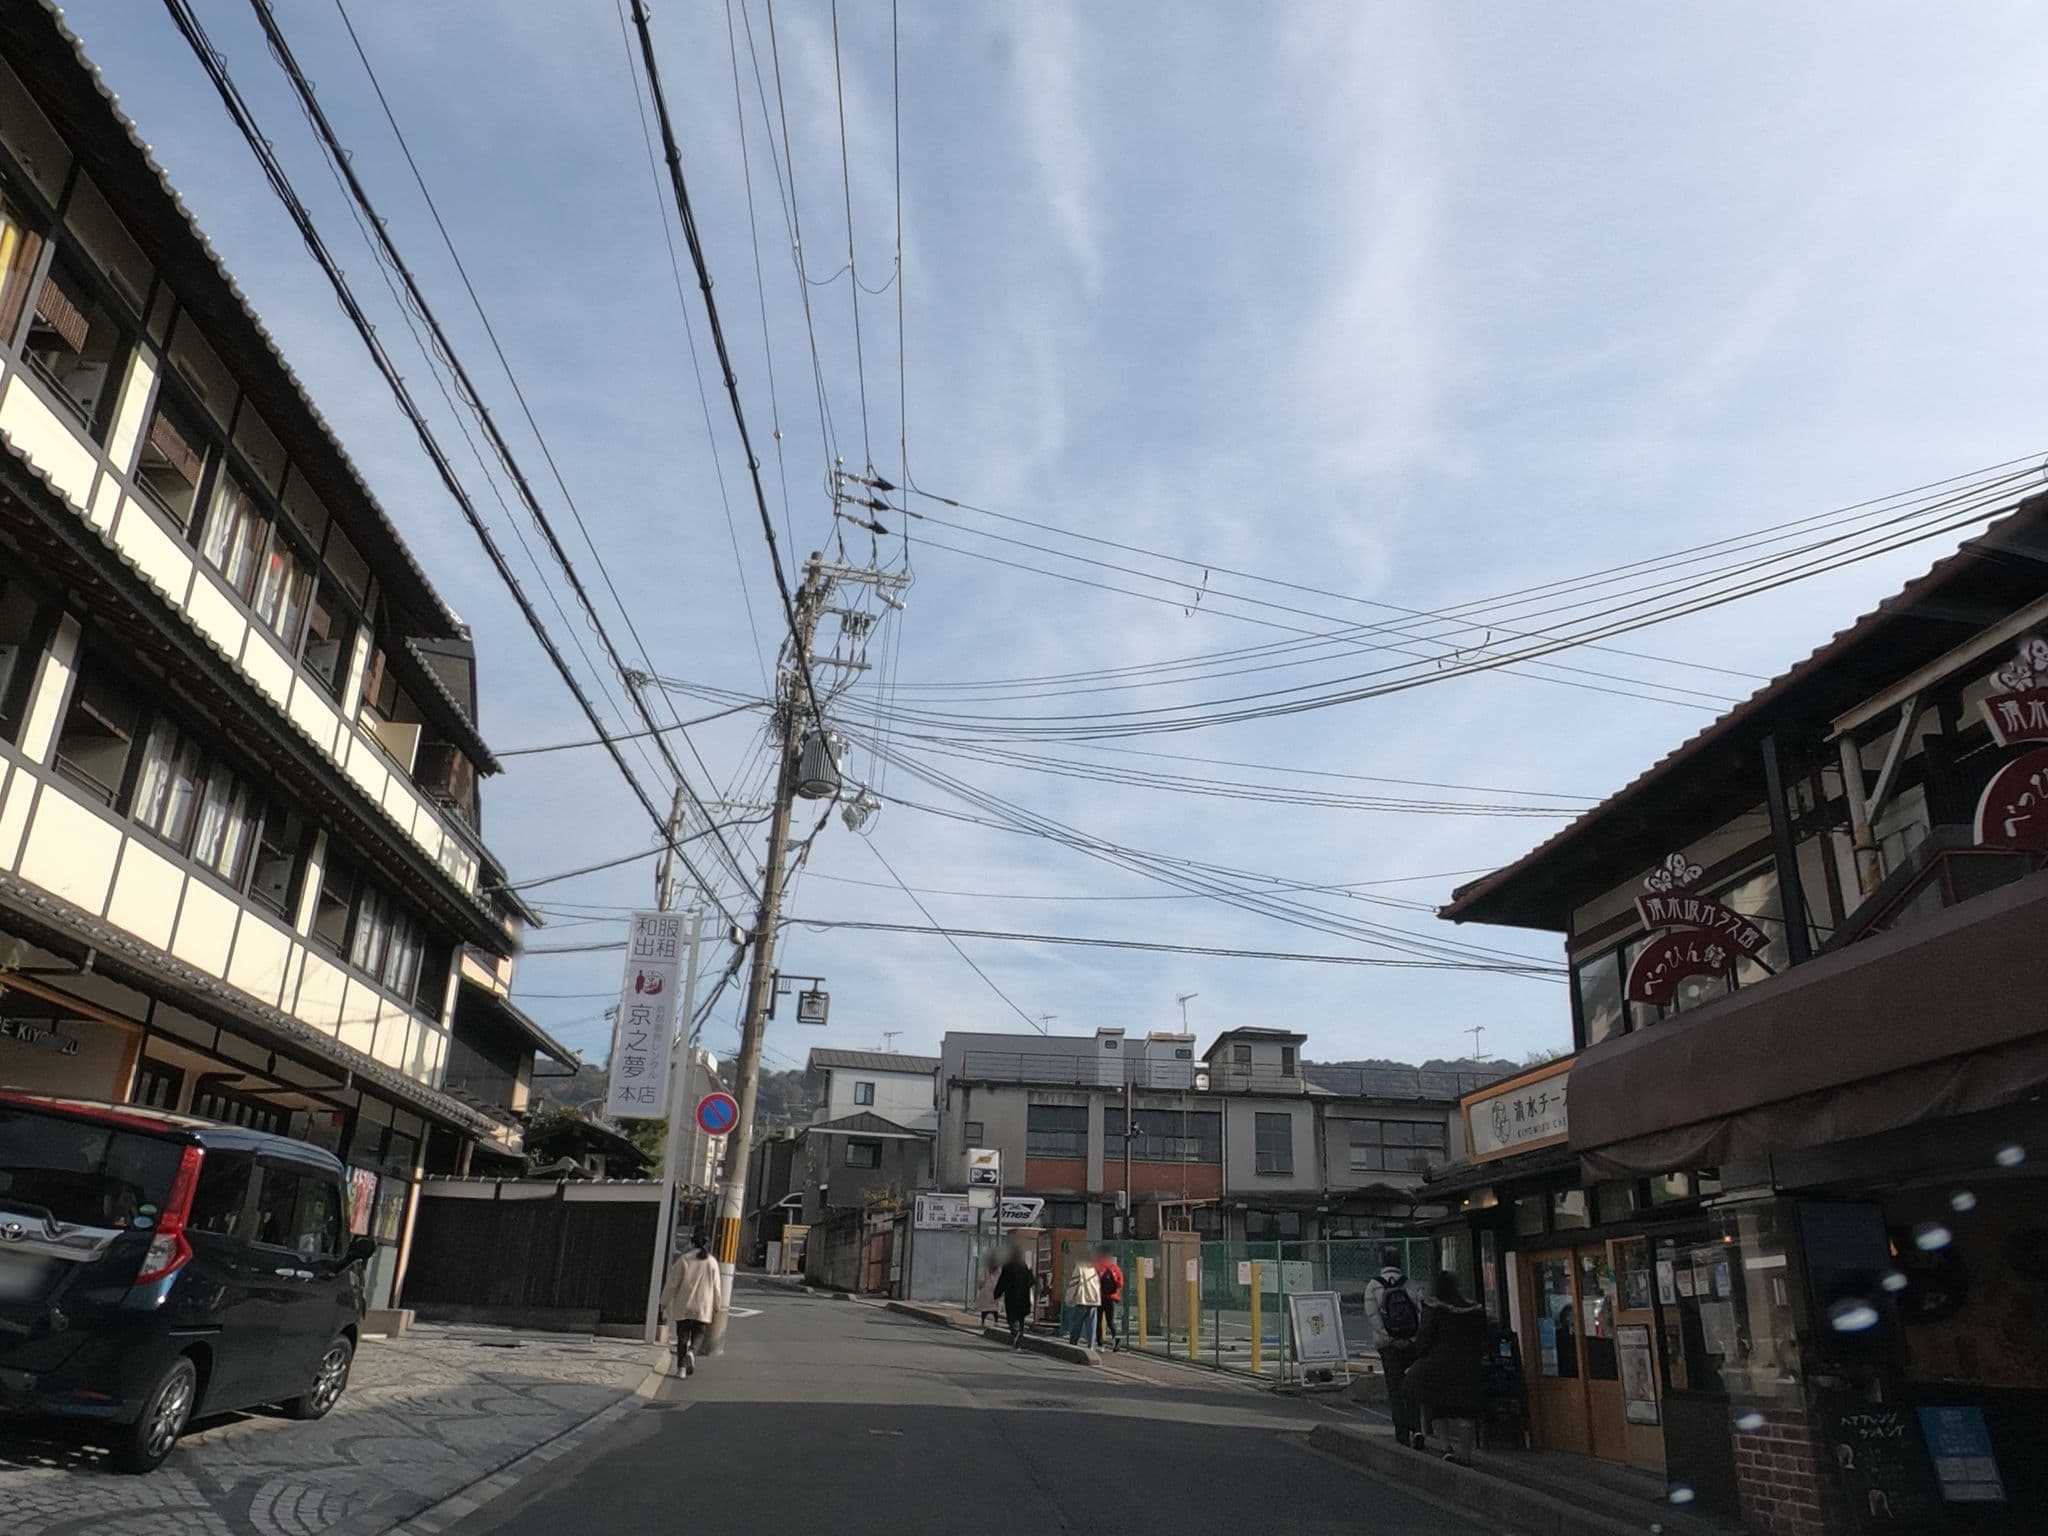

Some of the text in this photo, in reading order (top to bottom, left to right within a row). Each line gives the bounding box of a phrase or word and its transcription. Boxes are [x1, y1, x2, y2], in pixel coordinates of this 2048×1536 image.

[637, 917, 679, 937] 和服
[634, 938, 676, 959] 出租
[622, 1004, 652, 1079] 京之夢
[618, 1086, 657, 1104] 本店
